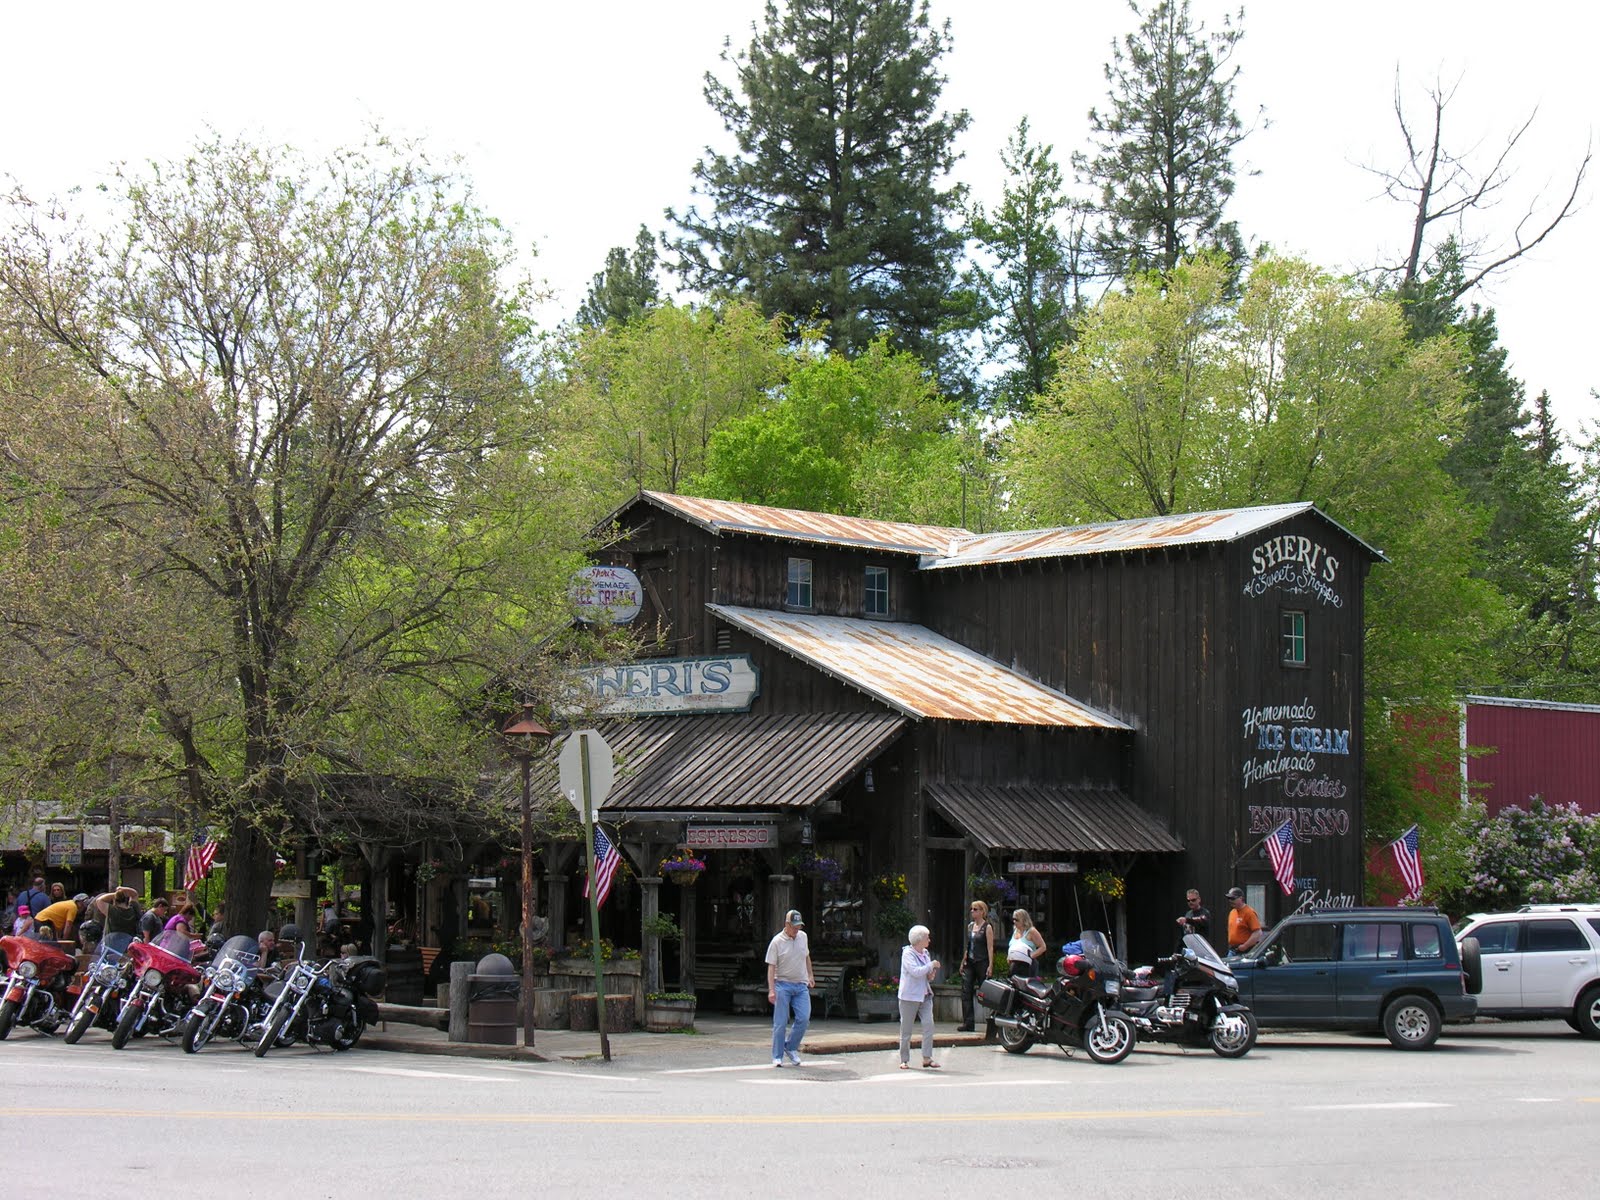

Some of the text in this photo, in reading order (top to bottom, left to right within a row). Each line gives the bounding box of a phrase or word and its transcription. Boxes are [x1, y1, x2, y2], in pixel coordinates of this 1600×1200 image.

[1252, 535, 1340, 582] SHERI'S
[590, 581, 630, 590] MEMADE
[1255, 563, 1343, 609] Sweet Shoppe
[1242, 697, 1316, 739] Homemade
[1257, 725, 1349, 755] ICE CREAM
[1242, 751, 1316, 788] Handmade
[687, 828, 769, 844] ESPRESSO
[1249, 805, 1349, 840] ESPRESSO
[1024, 863, 1060, 872] OPEN
